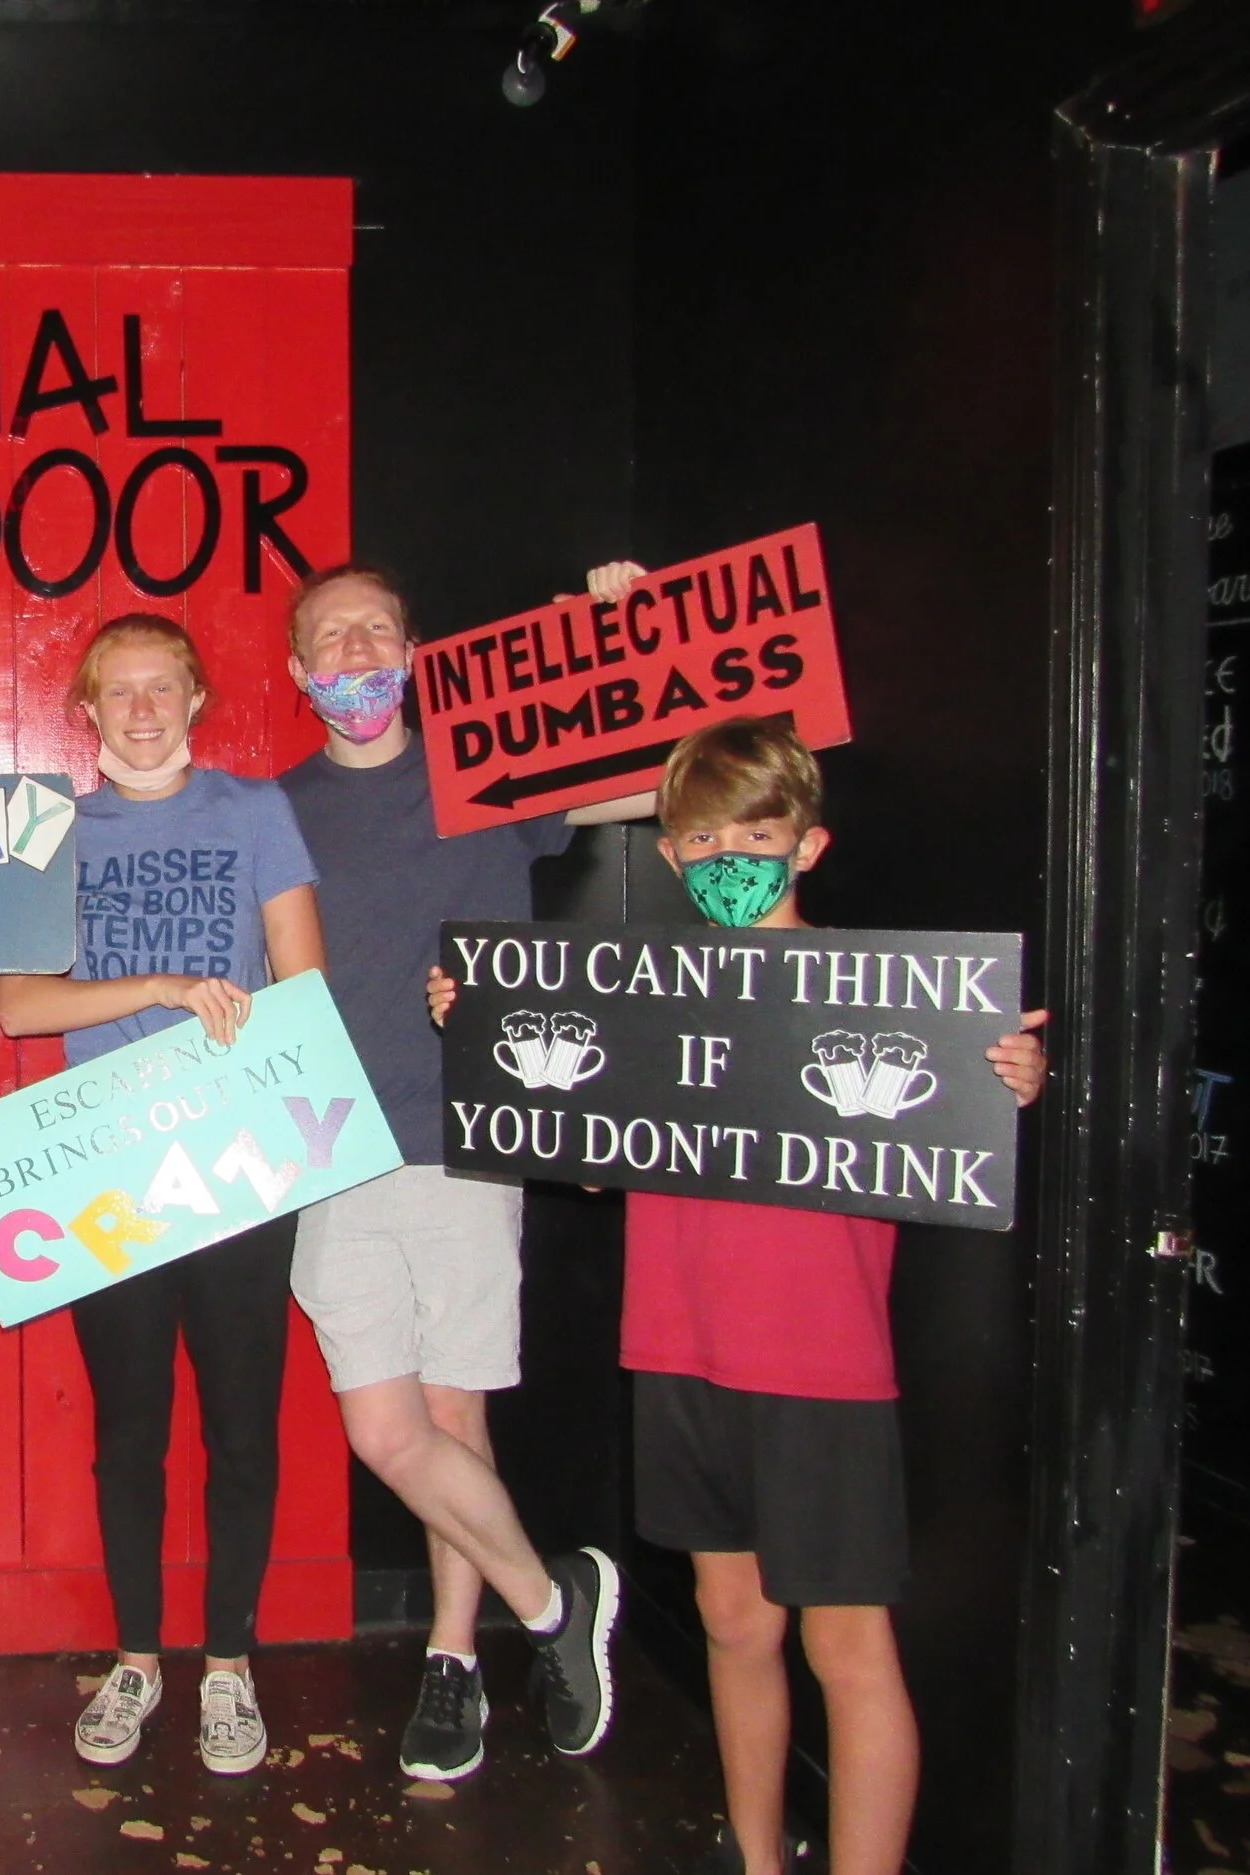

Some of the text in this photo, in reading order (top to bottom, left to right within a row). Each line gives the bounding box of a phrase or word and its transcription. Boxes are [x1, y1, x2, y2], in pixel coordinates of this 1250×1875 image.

[424, 544, 822, 716] INTELLECTUAL
[451, 634, 805, 772] DUMBASS
[77, 848, 239, 891] LAISSEZ
[142, 885, 237, 917] BONS
[81, 912, 235, 953] TEMPS
[453, 936, 1004, 1014] YOU CAN'T THINK
[147, 1073, 230, 1133] OUT
[240, 1043, 306, 1094] MY
[676, 1034, 732, 1089] IF
[451, 1101, 998, 1209] YOU DON'T DRINK
